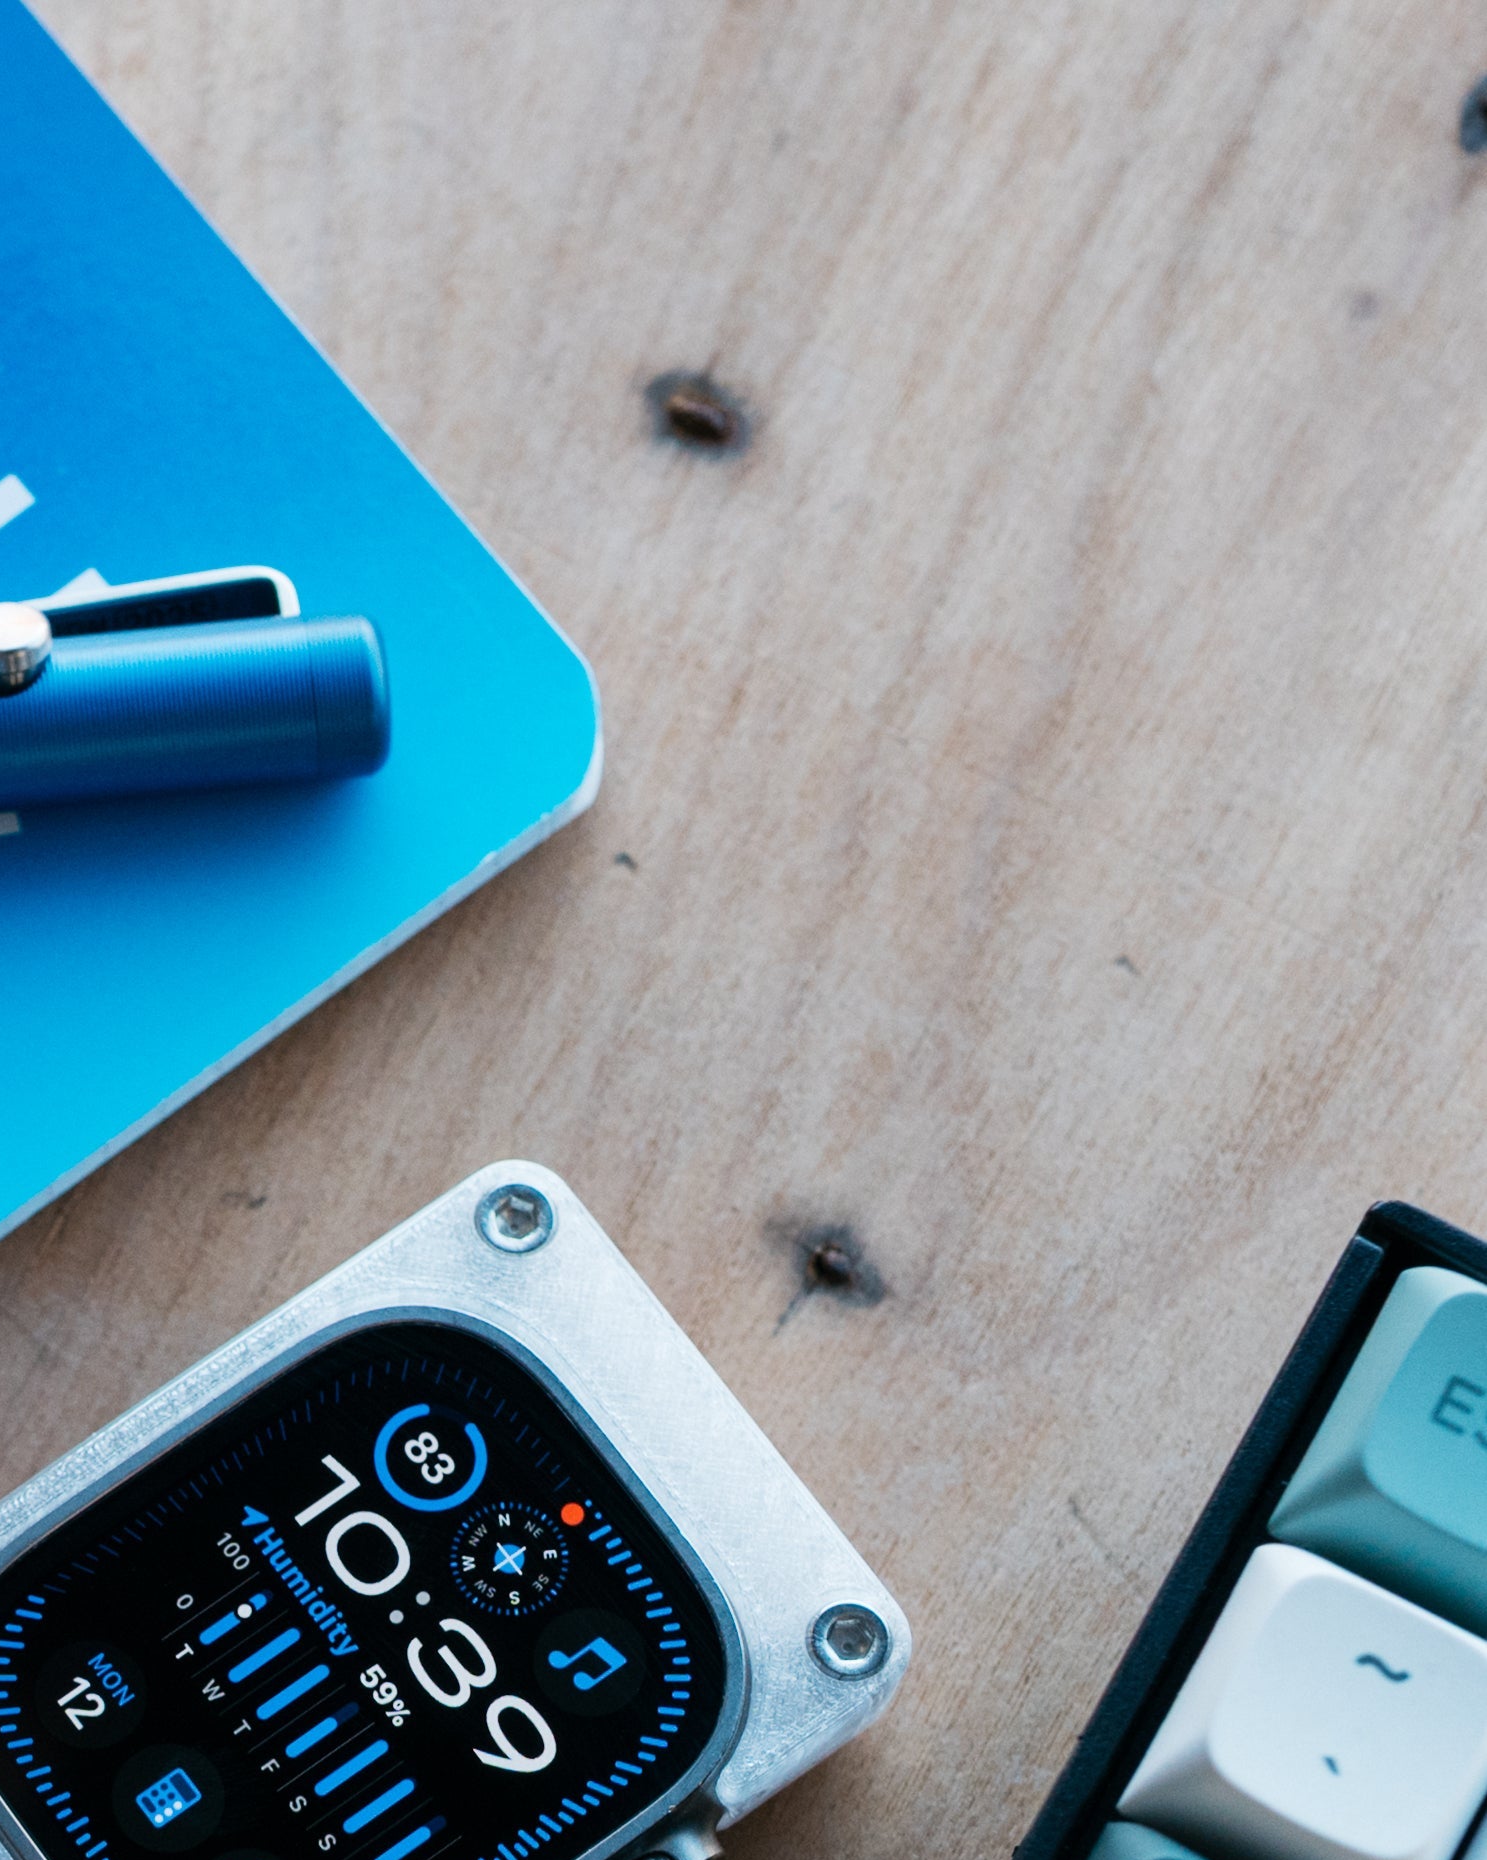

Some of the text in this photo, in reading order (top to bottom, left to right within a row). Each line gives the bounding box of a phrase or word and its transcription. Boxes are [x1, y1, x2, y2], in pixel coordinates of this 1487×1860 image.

[1431, 1376, 1487, 1450] E
[404, 1431, 455, 1484] 83
[498, 1513, 511, 1527] N
[524, 1520, 544, 1539] NE
[216, 1532, 250, 1570] 100
[461, 1555, 476, 1572] W
[543, 1549, 557, 1560] E
[176, 1593, 194, 1610] 0
[508, 1590, 520, 1605] S
[532, 1573, 549, 1592] SE
[252, 1526, 411, 1727] Humidity 59%
[294, 1454, 557, 1773] 10:39
[87, 1652, 136, 1707] MON
[57, 1676, 105, 1731] 12
[175, 1643, 194, 1660] T
[202, 1678, 226, 1701] W
[233, 1719, 252, 1735] T
[260, 1758, 280, 1773] F
[289, 1795, 307, 1813] S
[318, 1833, 337, 1851] S
